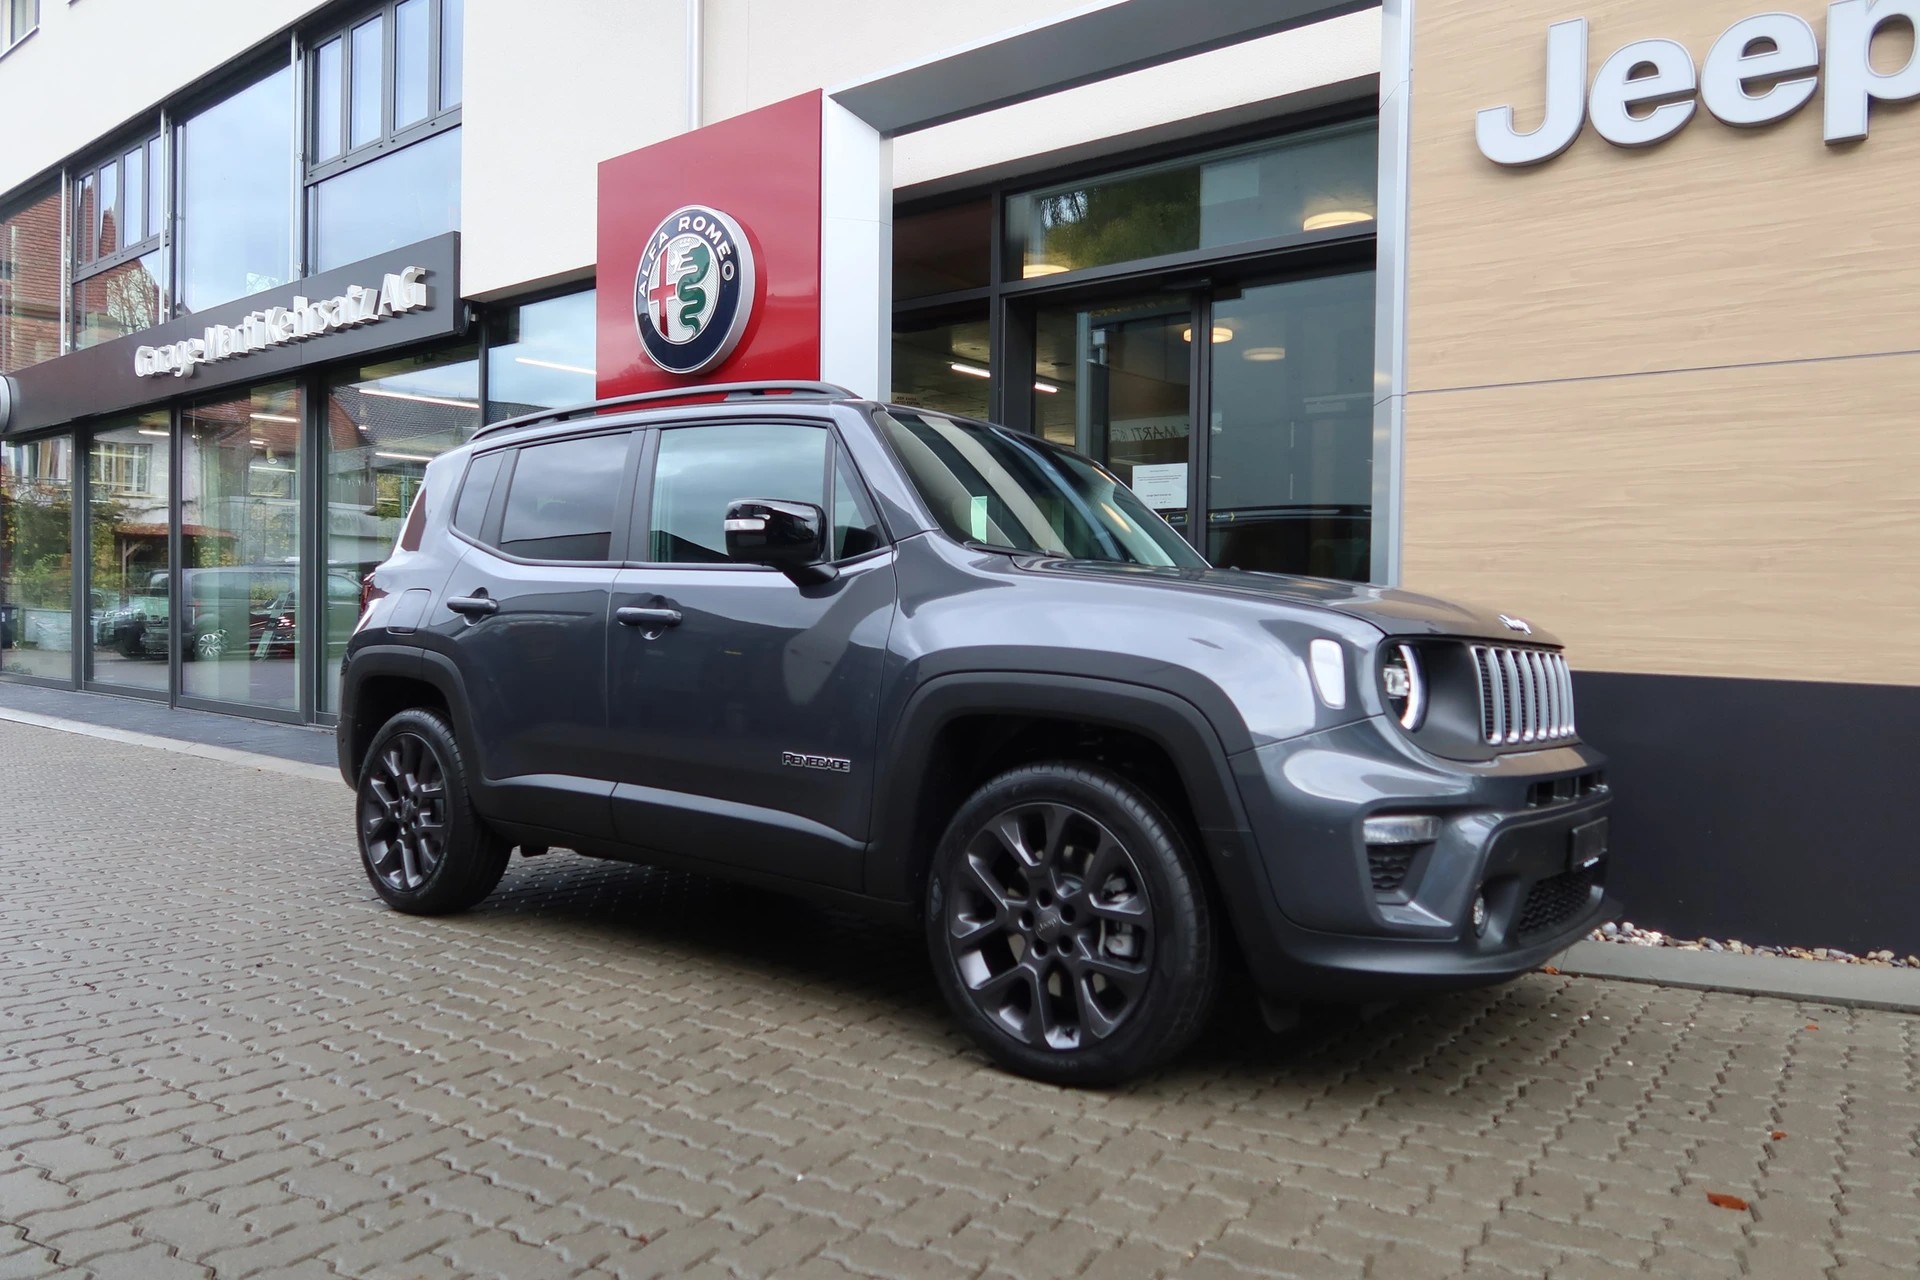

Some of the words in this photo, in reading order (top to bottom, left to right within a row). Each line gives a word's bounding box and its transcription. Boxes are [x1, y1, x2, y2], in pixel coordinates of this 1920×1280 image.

[1475, 0, 1920, 167] Jeep
[639, 231, 669, 298] ALFA
[678, 216, 735, 281] ROMEO
[135, 337, 205, 378] Garage
[204, 310, 265, 360] Marti
[378, 265, 427, 316] AG
[782, 751, 851, 773] RENEGADE
